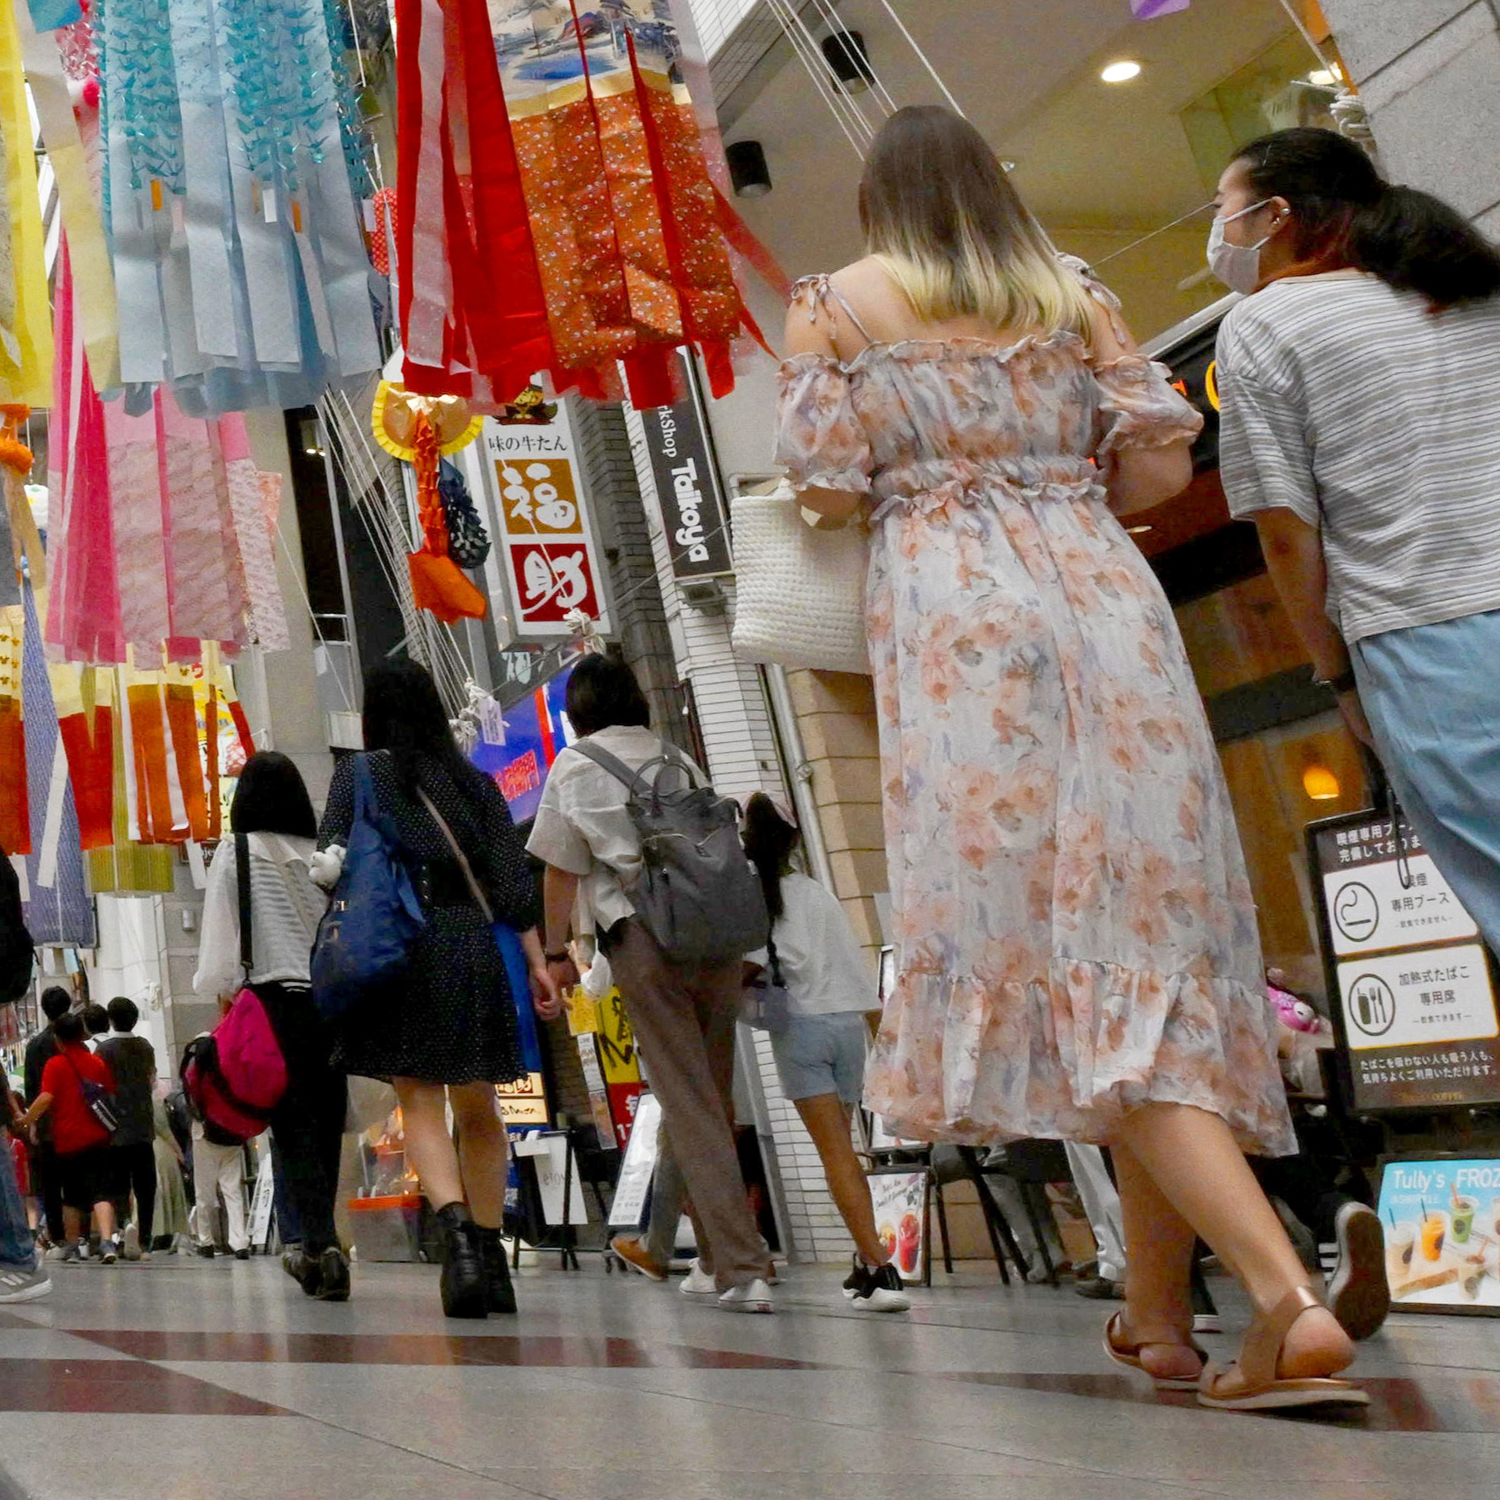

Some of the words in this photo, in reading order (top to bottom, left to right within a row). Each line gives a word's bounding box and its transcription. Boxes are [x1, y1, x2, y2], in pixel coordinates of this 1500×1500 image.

[488, 435, 568, 453] 味の牛たん
[658, 404, 678, 459] rkShop
[671, 457, 710, 563] Takoya
[1336, 823, 1414, 847] 喫煙専用ブー
[1338, 835, 1422, 864] 完備しておりま
[1391, 891, 1450, 913] 専用ブース
[1398, 964, 1470, 987] 加熱式たばこ
[1419, 989, 1457, 1007] 専用席
[1360, 1051, 1494, 1071] たばこを吸わない人も吸う人も、
[1362, 1064, 1497, 1085] 気持ちよくご利用いただけます。
[1393, 1169, 1446, 1193] Tully's
